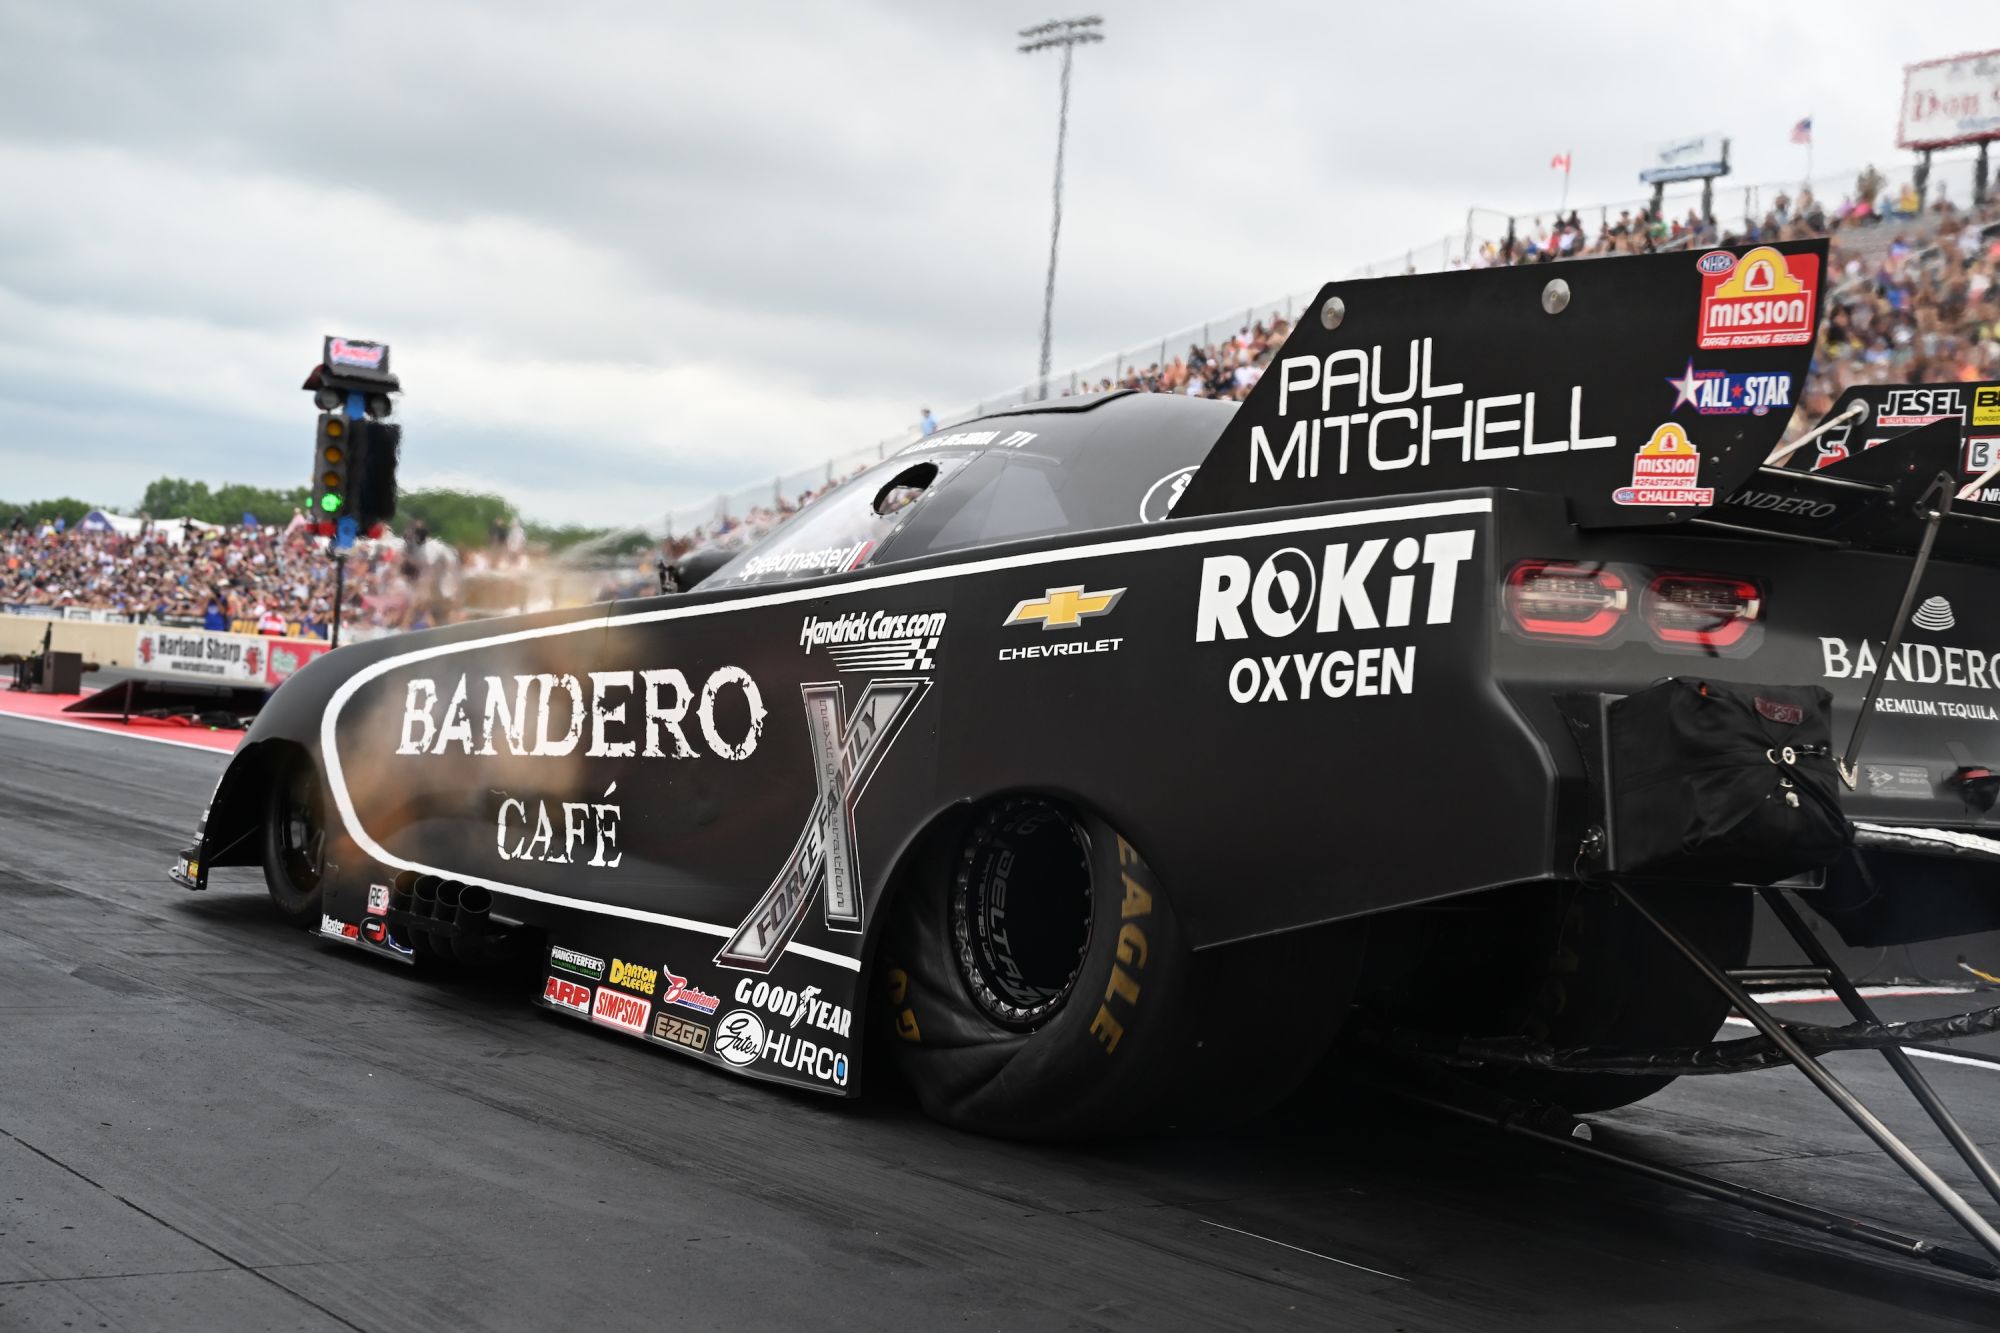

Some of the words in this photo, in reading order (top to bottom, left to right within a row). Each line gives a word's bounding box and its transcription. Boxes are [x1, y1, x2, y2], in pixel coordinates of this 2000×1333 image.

[1702, 255, 1732, 272] NHRA
[1709, 299, 1805, 328] MISSION
[1702, 336, 1731, 347] DRAG
[1730, 334, 1771, 346] RACING
[1771, 332, 1811, 344] SERIES
[1278, 336, 1464, 417] PAUL
[1700, 377, 1733, 408] ALL
[1743, 375, 1791, 407] STAR
[1879, 390, 1966, 417] JESEL
[1249, 385, 1618, 484] MITCHELL
[1637, 458, 1695, 473] MISSION
[1637, 491, 1711, 502] CHALLENGE
[799, 610, 947, 655] HendrickCars.com
[158, 634, 204, 659] Harland
[207, 638, 241, 663] Sharp
[999, 637, 1124, 661] CHEVROLET
[1228, 645, 1416, 704] OXYGEN
[395, 665, 769, 761] BANDERO
[1863, 696, 1938, 717] REMIUM
[1937, 700, 2000, 721] TEQUILA
[496, 780, 623, 868] CAFÉ
[756, 831, 818, 951] FORCE
[817, 697, 878, 846] FAMILY
[1089, 833, 1153, 1055] EAGLE
[551, 947, 604, 972] HANGSTERFER'S
[609, 958, 658, 984] DARTON
[546, 978, 590, 1007] ARP
[620, 976, 656, 995] SLEEVES
[596, 991, 647, 1028] SIMPSON
[715, 1017, 760, 1057] Gates
[761, 1028, 849, 1087] HURCO
